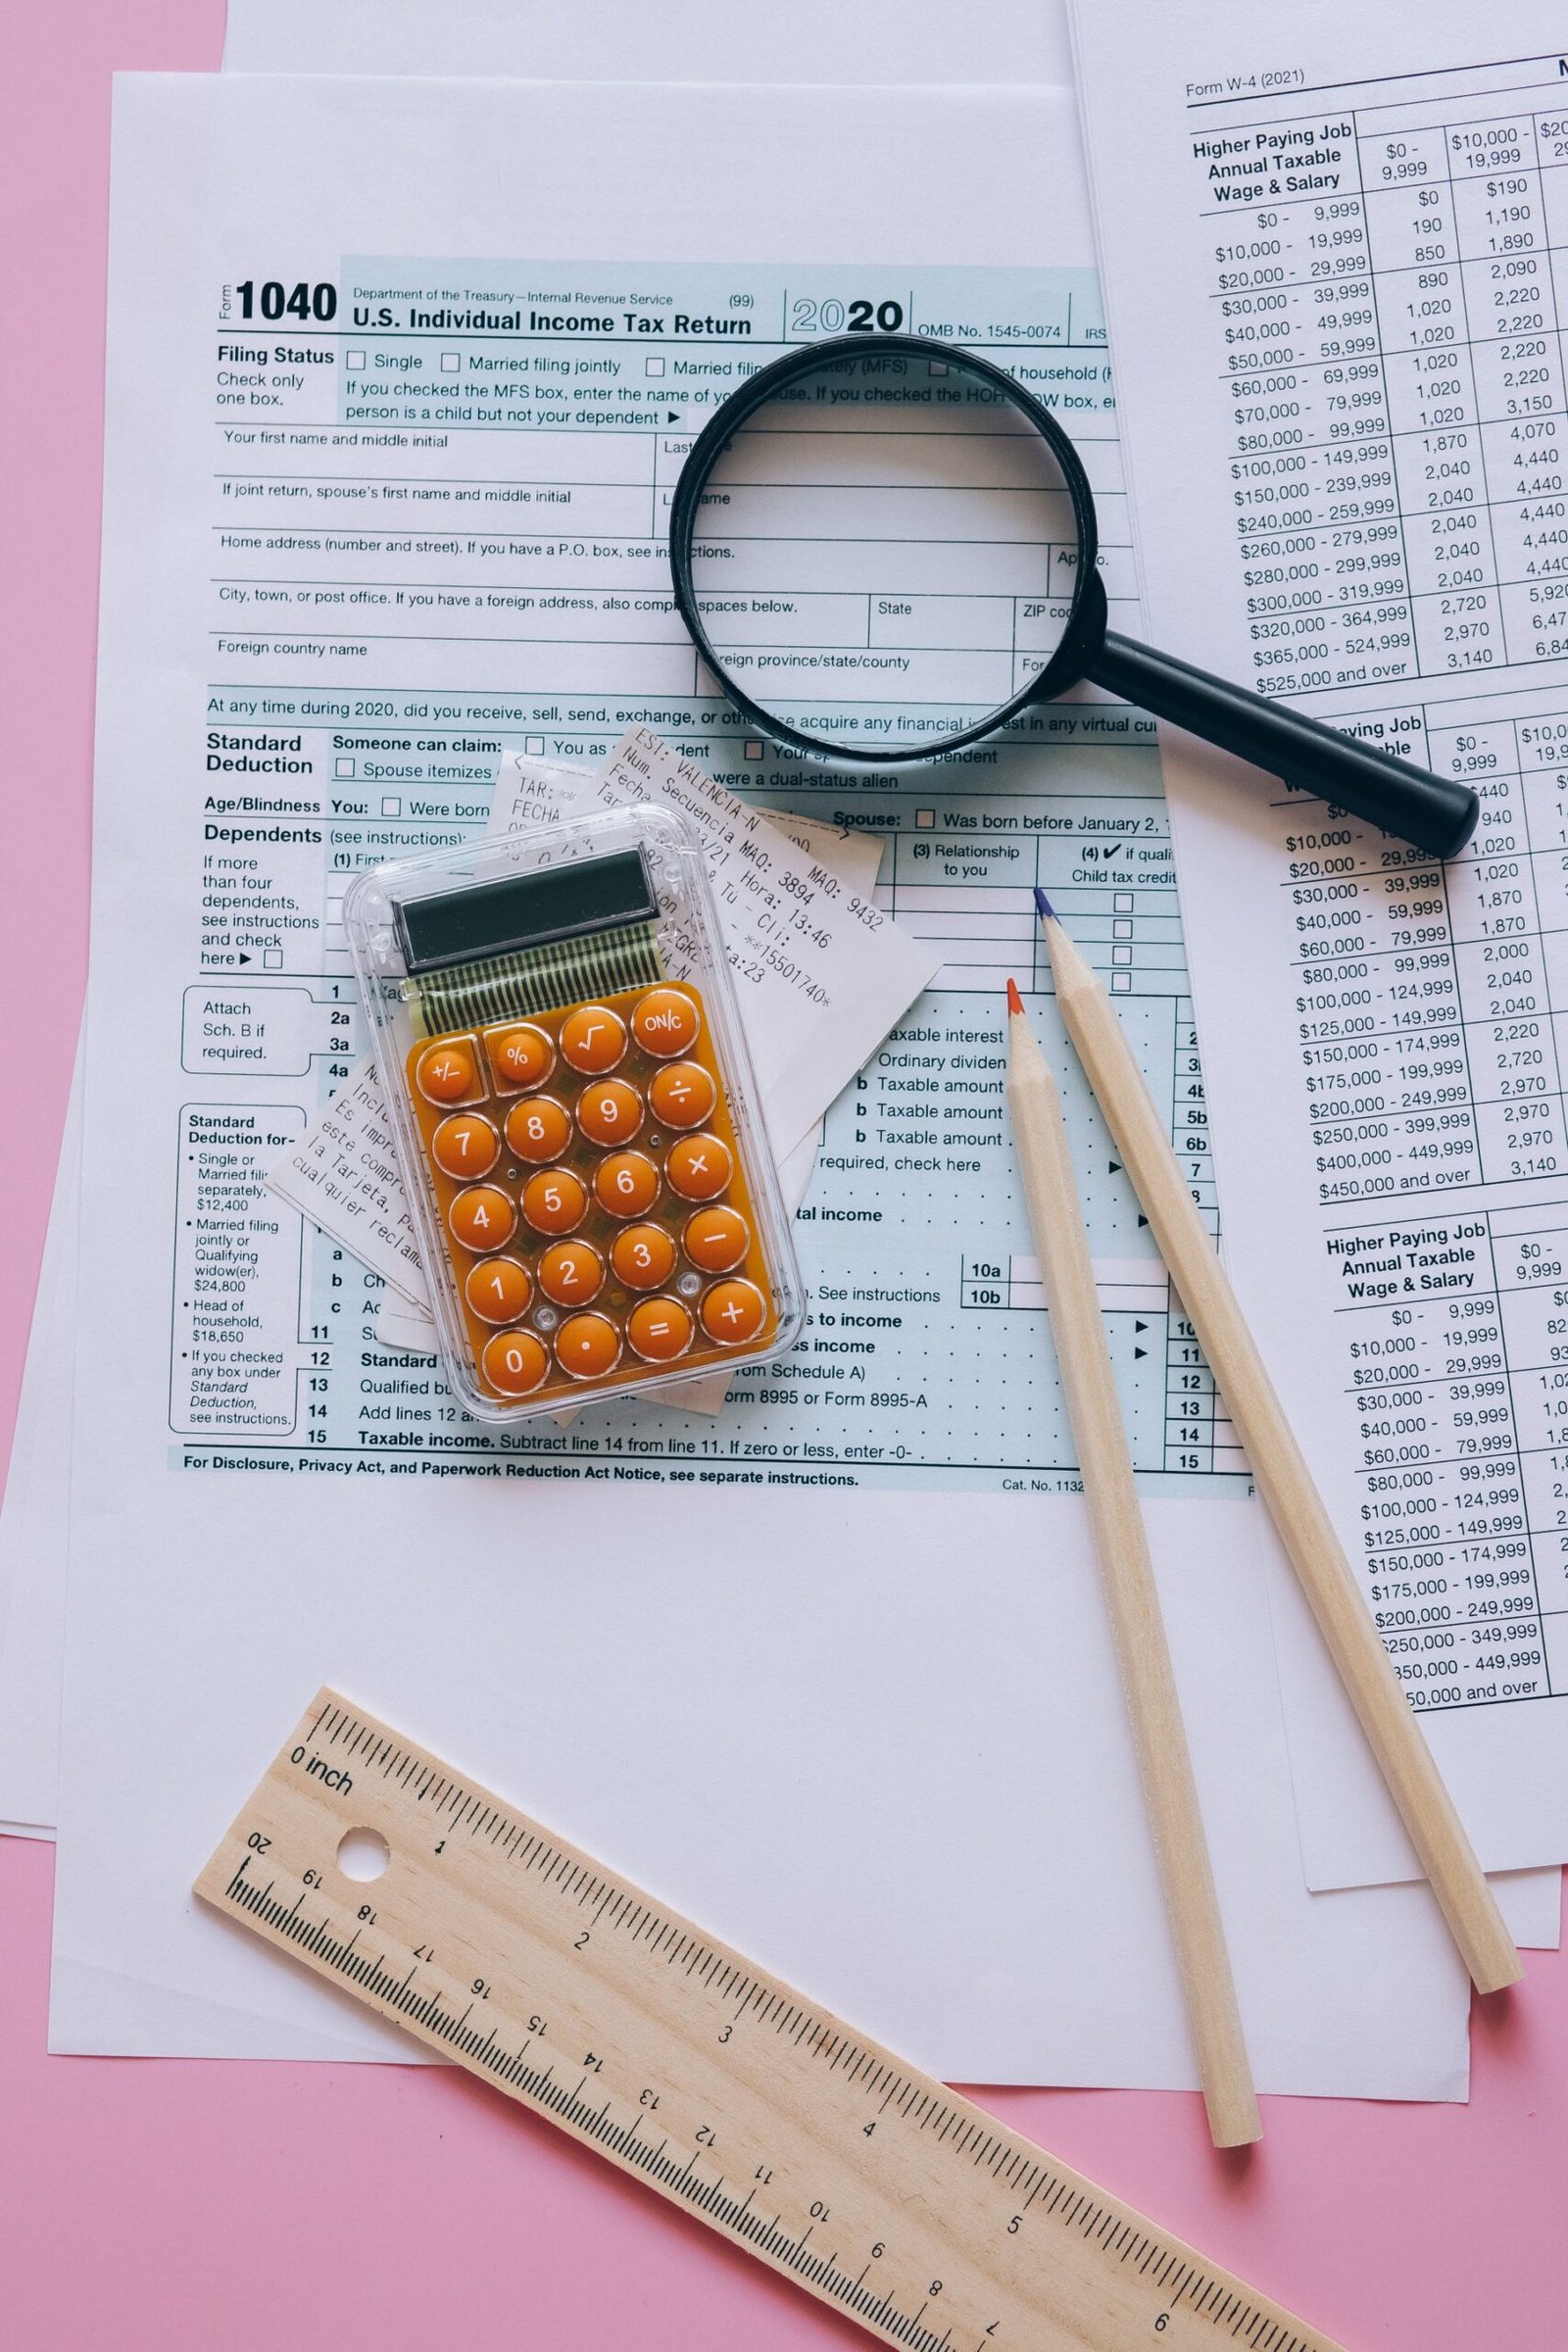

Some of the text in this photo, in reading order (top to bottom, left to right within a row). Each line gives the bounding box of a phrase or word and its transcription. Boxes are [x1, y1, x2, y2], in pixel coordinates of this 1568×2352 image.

[1186, 69, 1303, 96] Form W-4 (2021)
[1194, 123, 1351, 159] Higher Paying Job
[1452, 128, 1517, 151] $10,000
[1387, 143, 1406, 159] $0
[1466, 149, 1521, 169] 19,999
[1208, 148, 1341, 179] Annual Taxable
[1382, 161, 1427, 180] 9,999
[1213, 174, 1340, 202] Wage & Salary
[1486, 206, 1531, 223] 1,190
[1413, 218, 1442, 233] 190
[1215, 229, 1362, 263] $10,000 19,999
[220, 280, 337, 321] Form 1040
[354, 288, 421, 300] Department
[427, 290, 437, 300] of
[442, 290, 460, 300] the
[575, 293, 625, 304] Revenue
[630, 294, 672, 305] Service
[729, 294, 754, 309] (99)
[354, 308, 751, 335] U.S. Individual Income Tax Return
[792, 299, 904, 333] 2020
[918, 323, 1060, 337] OMB No. 1545-0074
[218, 345, 334, 366] Filing Status
[374, 354, 421, 371] Single
[470, 357, 620, 376] Married filing jointly
[218, 372, 304, 390] Check only
[347, 380, 710, 402] If you checked the MFS box, enter the name of
[217, 392, 283, 406] one box.
[224, 431, 447, 447] Your first name and middle initial
[1514, 449, 1558, 468] 4,440
[1425, 461, 1470, 480] 2,040
[1235, 472, 1391, 506] $150,000 239,999
[878, 602, 911, 614] State
[1023, 604, 1045, 617] ZIP
[219, 640, 367, 658] Foreign country name
[1448, 649, 1492, 668] 3,140
[759, 655, 909, 671] province/state/county
[1256, 663, 1407, 694] $525,000 and over
[207, 733, 301, 751] Standard
[333, 735, 502, 753] Someone can claim:
[207, 755, 312, 774] Deduction
[204, 796, 319, 813] Age/Blindness
[676, 760, 760, 832] VALENCIA-N
[512, 799, 561, 822] FECHA
[662, 777, 735, 843] Secuencia
[205, 824, 321, 845] Dependents
[913, 843, 1019, 860] (3) Relationship
[778, 871, 815, 906] 3894
[808, 865, 884, 932] MAQ: 9432
[740, 870, 832, 948] Hora: 13:46
[204, 1002, 251, 1014] Attach
[331, 1011, 349, 1025] 2a
[204, 1023, 265, 1037] Sch. B if
[644, 1008, 682, 1032] ON/C
[203, 1046, 267, 1060] required.
[329, 1037, 349, 1051] 3a
[600, 1099, 618, 1123] 9
[876, 1103, 1004, 1119] Taxable amount
[189, 1115, 255, 1128] Standard
[527, 1116, 545, 1140] 8
[189, 1131, 263, 1145] Deduction
[455, 1132, 471, 1156] 7
[1511, 1156, 1556, 1176] 3,140
[293, 1156, 367, 1218] cualquier
[331, 1153, 389, 1213] Tarjeta,
[616, 1170, 635, 1194] 6
[1319, 1170, 1470, 1200] $450,000 and over
[197, 1198, 248, 1211] $12,400
[544, 1188, 562, 1212] 5
[473, 1205, 490, 1228] 4
[633, 1244, 652, 1268] 3
[559, 1260, 578, 1286] 2
[972, 1264, 1001, 1278] 10a
[194, 1279, 245, 1293] $24,800
[490, 1277, 504, 1300] 1
[819, 1286, 941, 1302] See instructions
[971, 1290, 1001, 1303] 10b
[193, 1315, 263, 1329] household,
[192, 1330, 243, 1343] $18,650
[506, 1349, 523, 1373] 0
[870, 1394, 927, 1407] 8995-A
[308, 1430, 326, 1443] 15
[359, 1431, 495, 1448] Taxable income.
[184, 1456, 502, 1478] For Disclosure, Privacy Act, and Paperwork
[1368, 1462, 1515, 1493] $80,000 99,999
[290, 1746, 353, 1795] 0 inch
[247, 1833, 271, 1855] 20
[302, 1869, 323, 1889] 19
[357, 1905, 377, 1925] 18
[574, 1933, 590, 1950] 2
[527, 2016, 547, 2036] 15
[718, 2026, 733, 2043] 3
[639, 2089, 660, 2109] 13
[696, 2126, 715, 2147] 12
[862, 2123, 876, 2137] 4
[809, 2201, 830, 2223] 10
[1007, 2215, 1023, 2234] 5
[1154, 2313, 1170, 2331] 6
